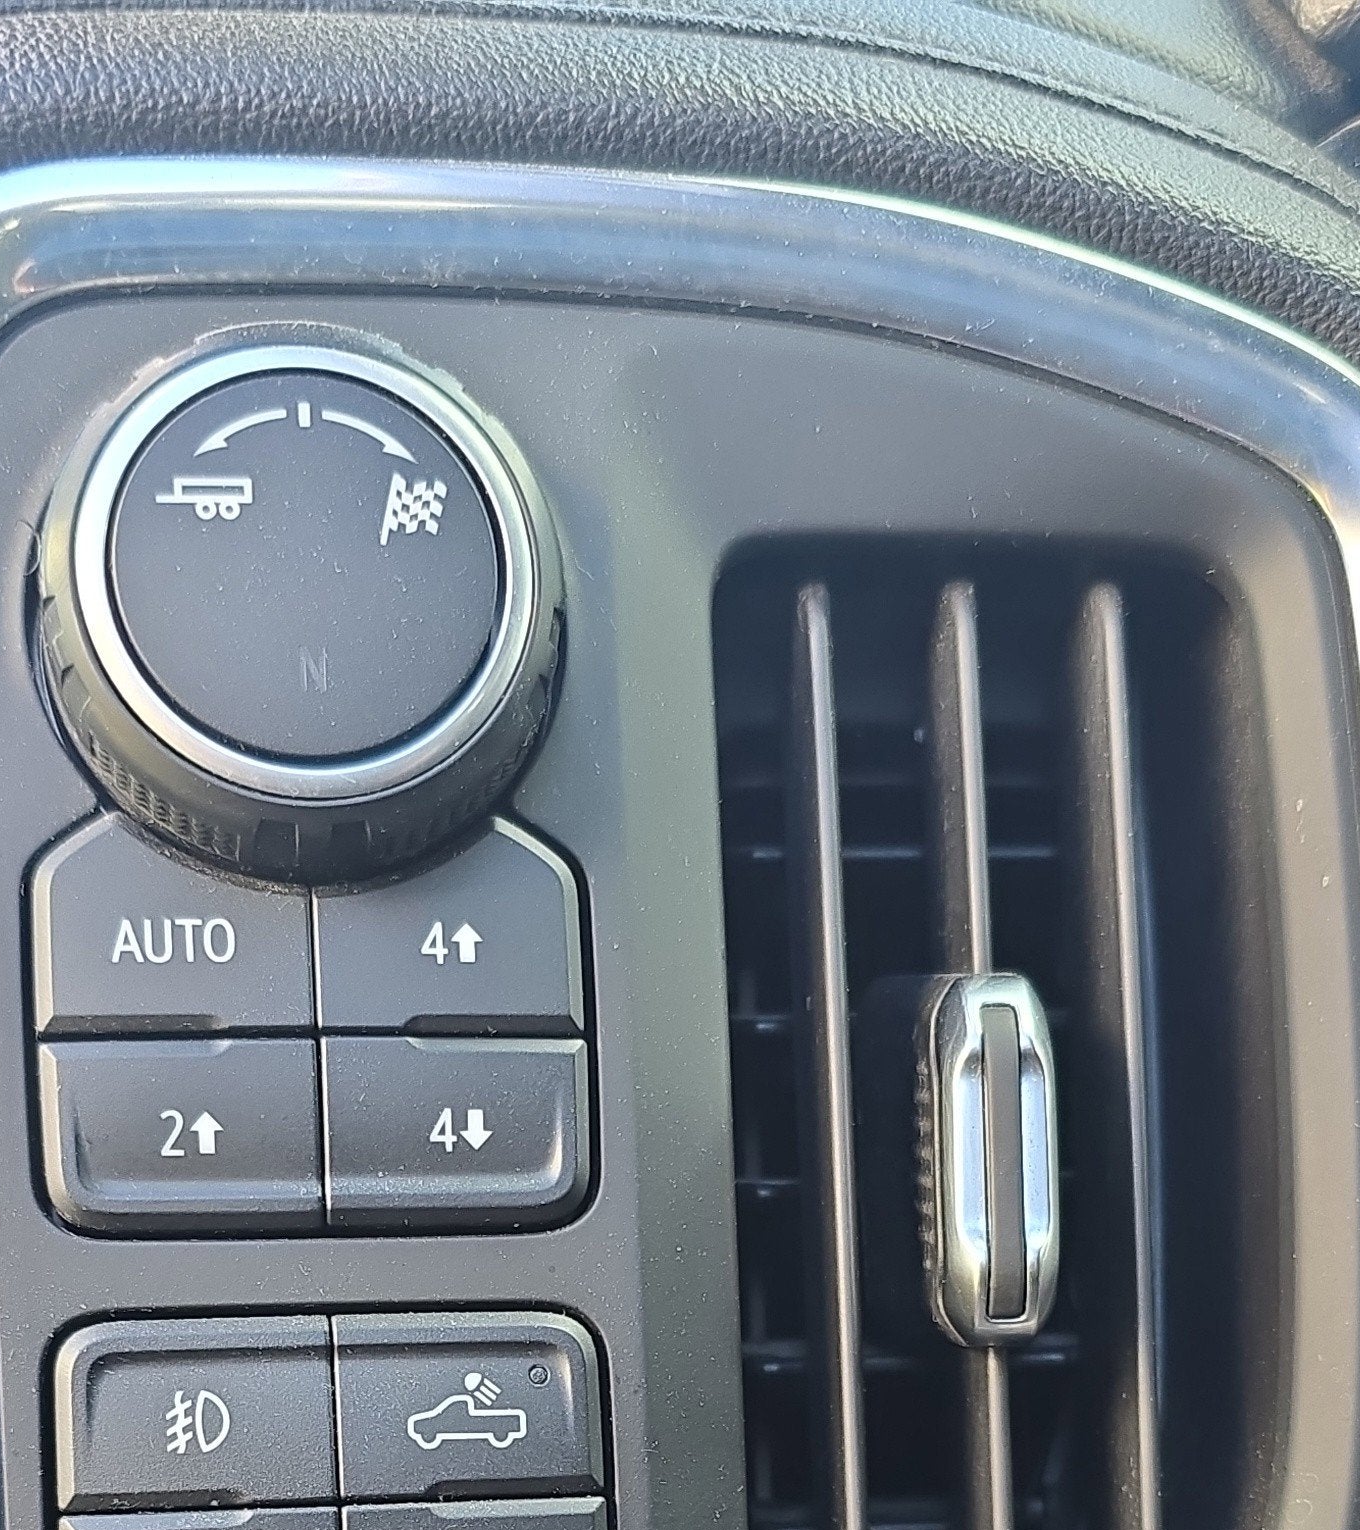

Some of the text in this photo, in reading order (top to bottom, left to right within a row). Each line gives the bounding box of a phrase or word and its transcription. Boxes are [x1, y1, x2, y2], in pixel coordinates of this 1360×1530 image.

[111, 918, 236, 964] AUTO
[420, 921, 449, 965] 4
[159, 1110, 185, 1157] 2
[429, 1108, 458, 1153] 4
